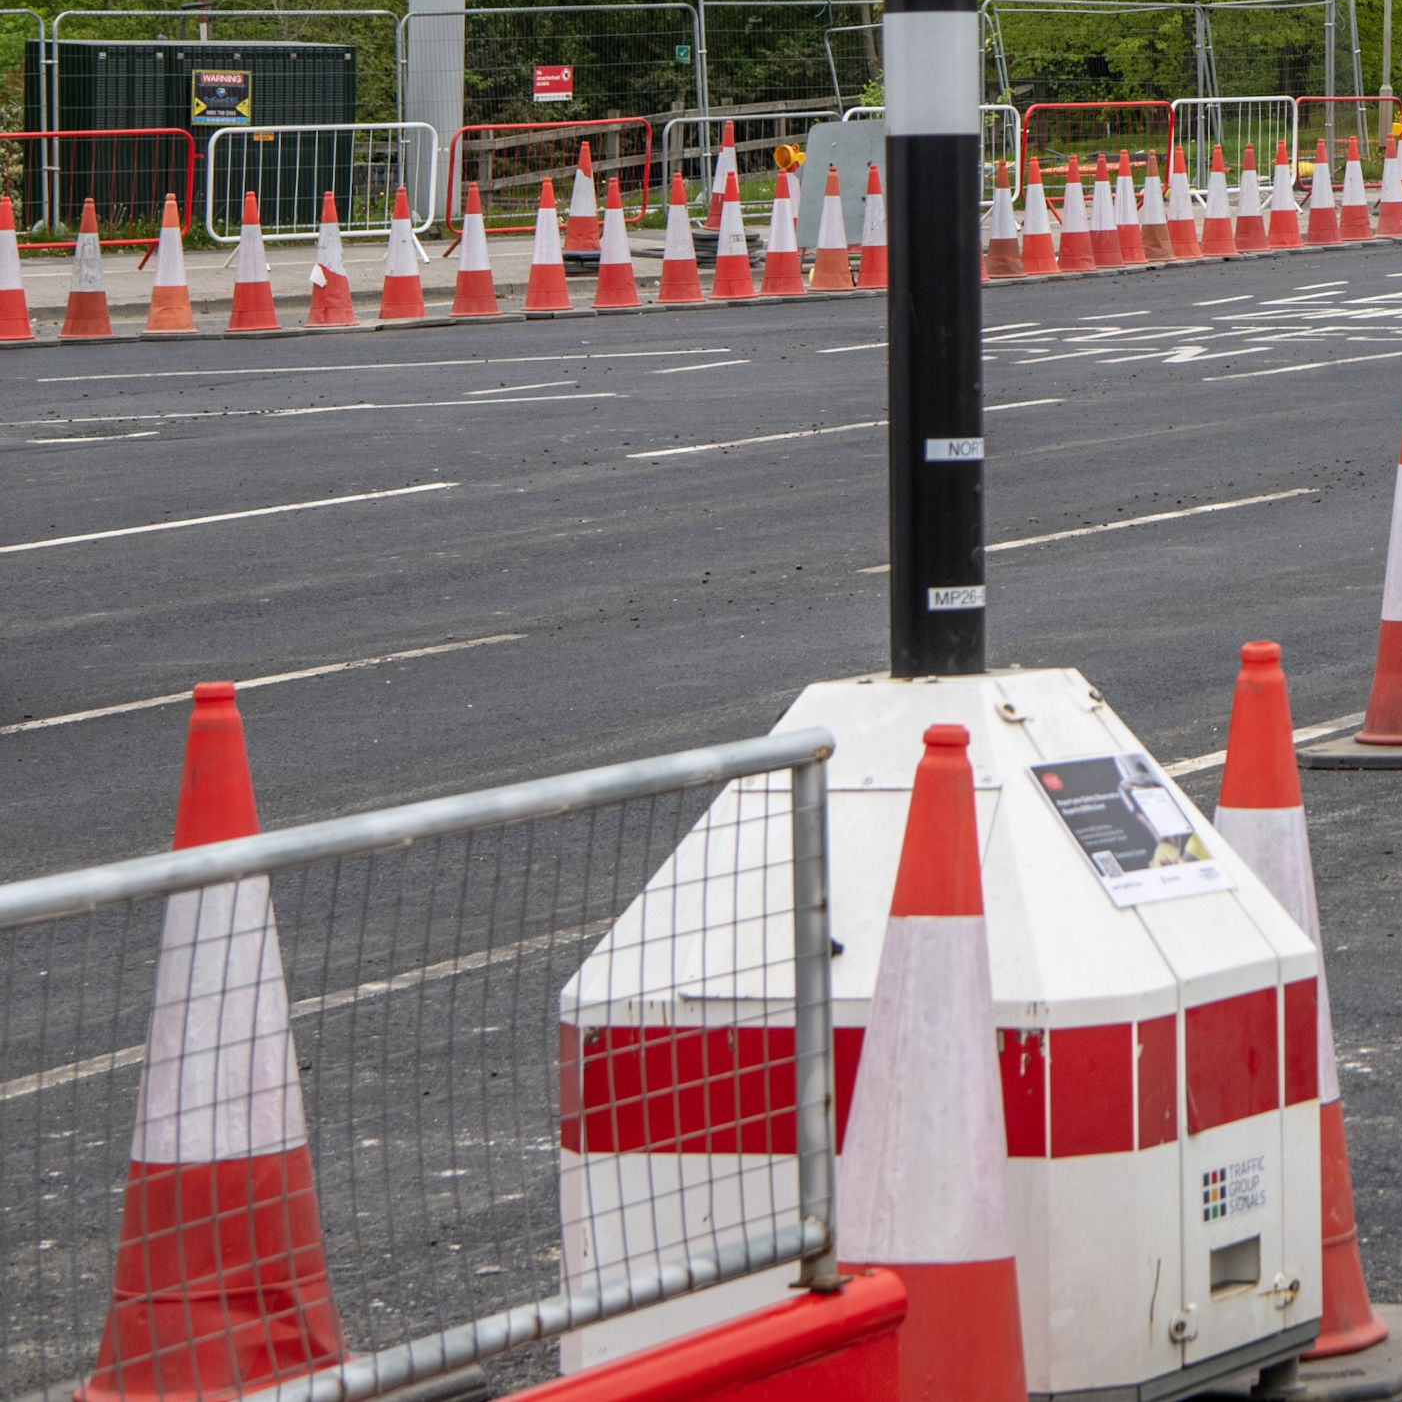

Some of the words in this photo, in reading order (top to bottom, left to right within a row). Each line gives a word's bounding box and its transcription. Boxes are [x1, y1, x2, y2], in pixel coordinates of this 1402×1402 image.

[202, 74, 242, 83] WARNING
[948, 441, 984, 457] NOR
[1228, 1154, 1265, 1179] TRAFFIC
[1228, 1174, 1260, 1197] GROUP
[1228, 1189, 1266, 1214] SIGNALS
